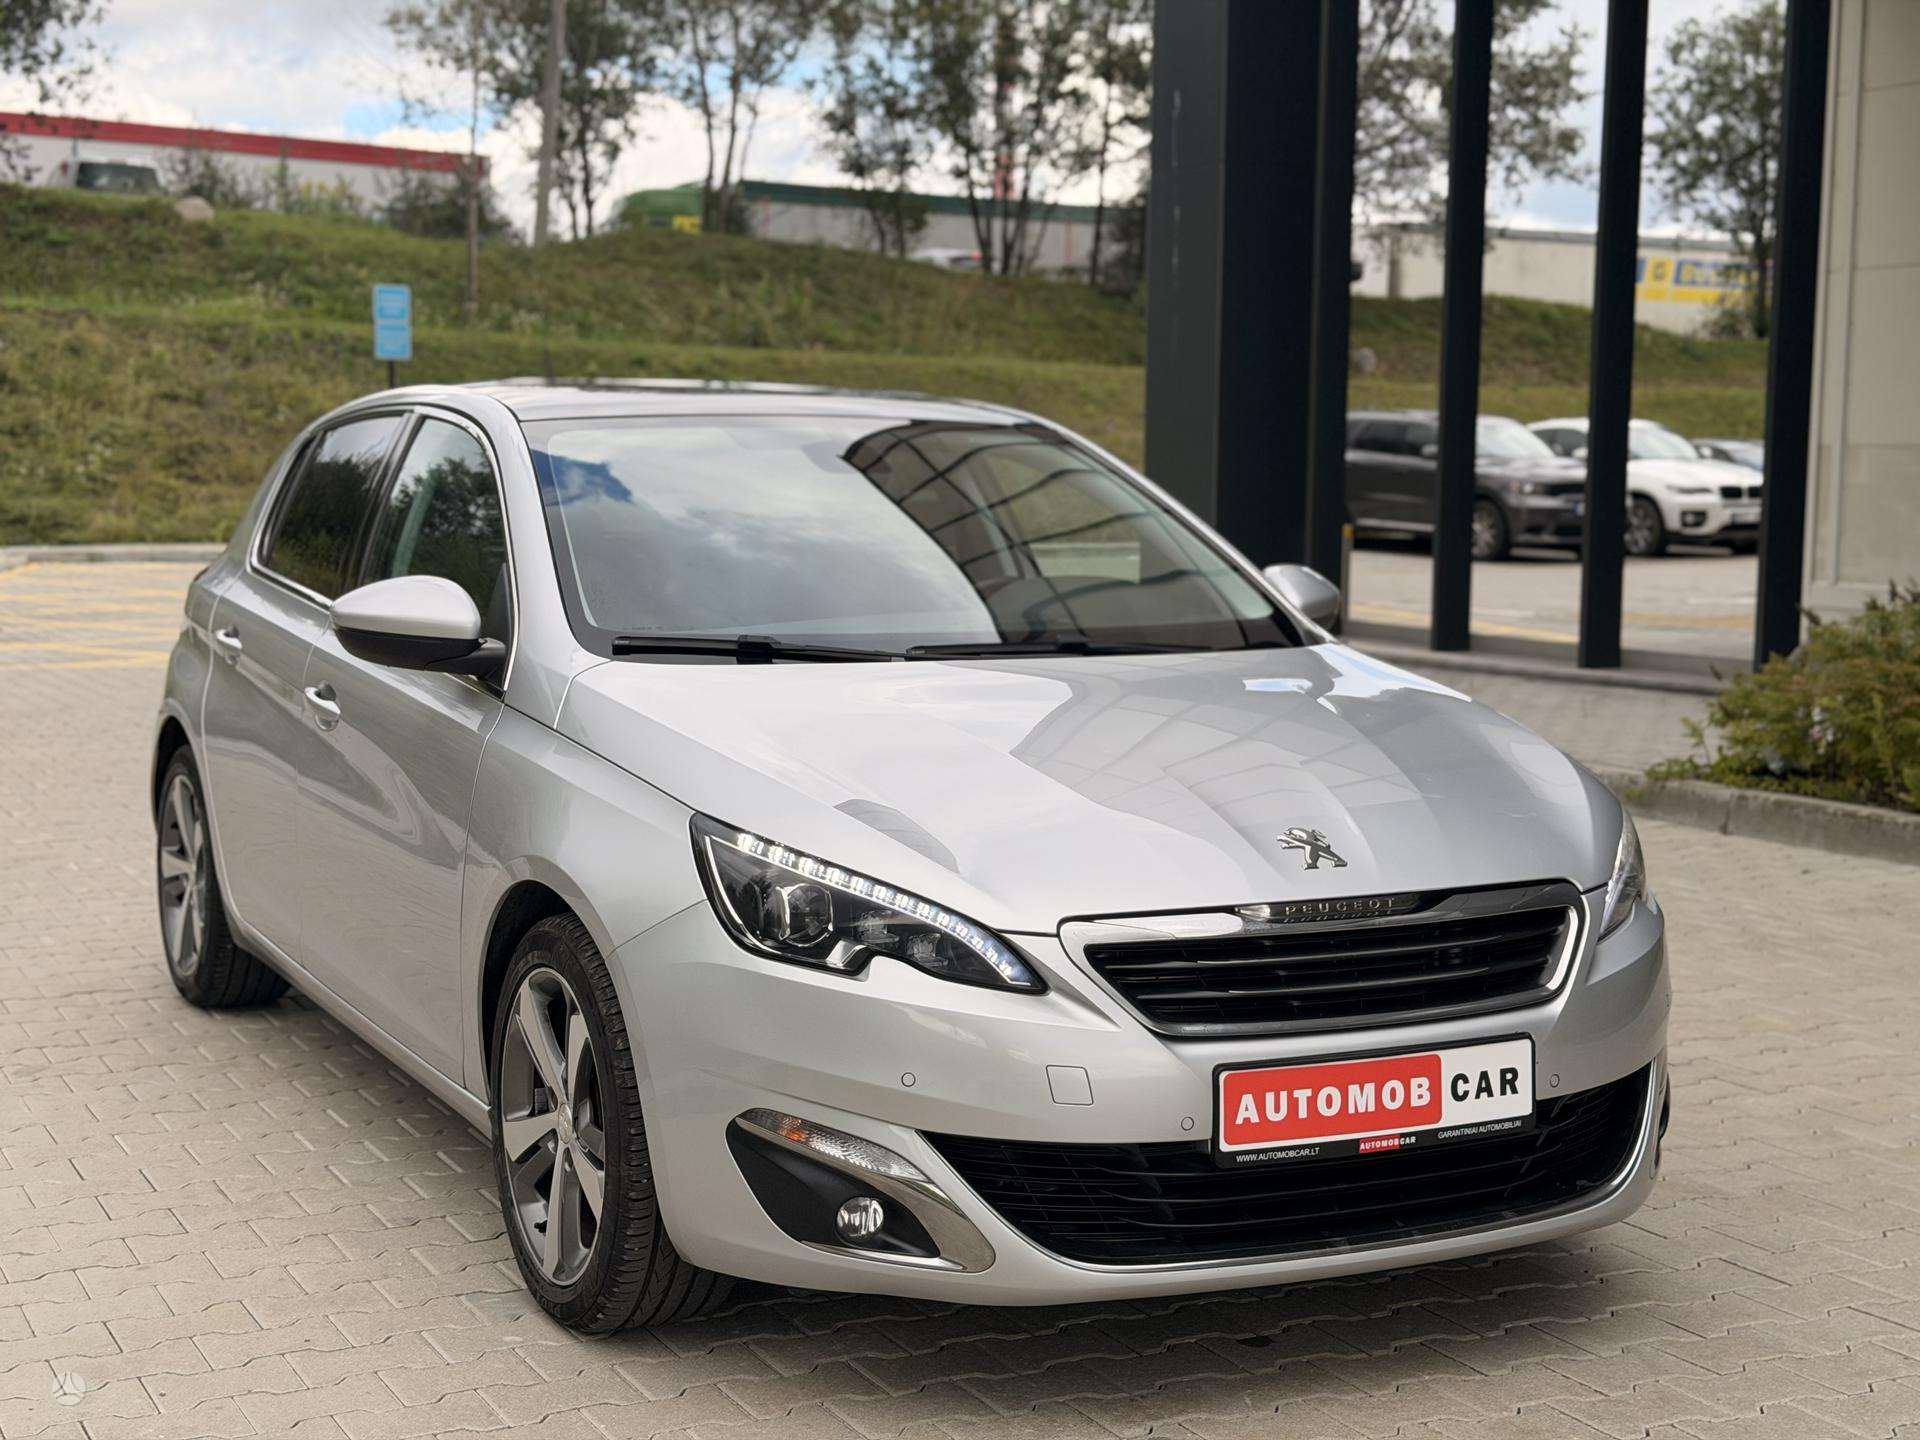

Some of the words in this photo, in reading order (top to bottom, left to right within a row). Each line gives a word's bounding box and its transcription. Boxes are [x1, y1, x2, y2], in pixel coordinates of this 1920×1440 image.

[1285, 897, 1394, 916] PEUGEOT
[1235, 1076, 1432, 1126] AUTOMOB
[1450, 1066, 1520, 1103] CAR
[1437, 1126, 1478, 1139] GARANTINIAI
[1478, 1119, 1522, 1134] AUTOMOBILIAI
[1235, 1147, 1320, 1163] WWW.AUTOMOBCAR.LT
